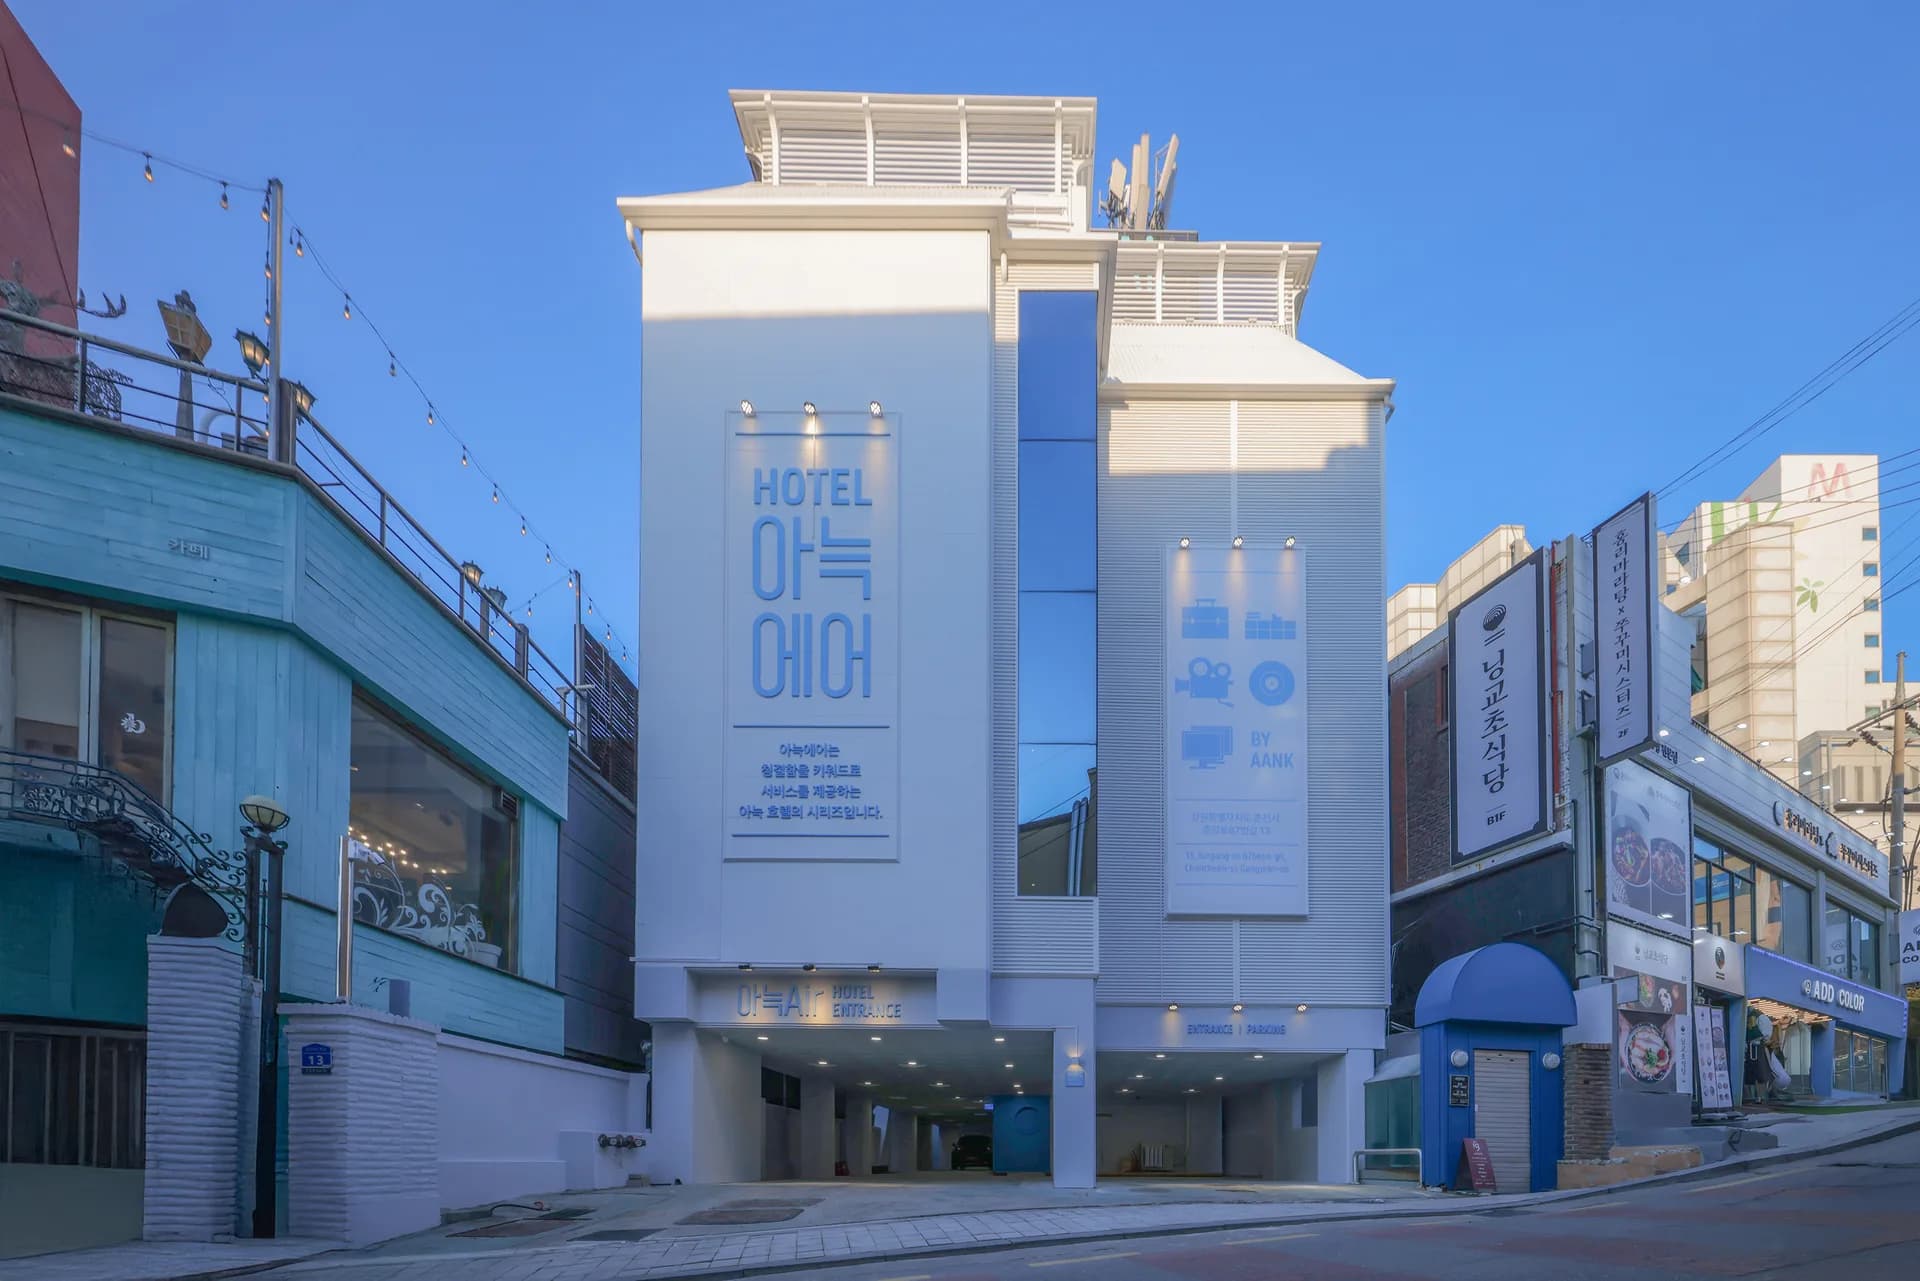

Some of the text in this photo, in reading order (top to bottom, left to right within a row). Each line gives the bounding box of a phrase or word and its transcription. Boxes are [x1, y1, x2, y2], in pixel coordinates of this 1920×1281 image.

[753, 467, 873, 506] HOTEL
[167, 538, 209, 560] 카페
[752, 514, 871, 601] 아늑
[752, 612, 871, 698] 에어
[1480, 648, 1509, 794] 닝교초식당
[1250, 731, 1271, 747] BY
[1617, 728, 1630, 739] 2F
[779, 743, 840, 758] 아늑에어는
[1250, 752, 1295, 769] AANK
[761, 764, 862, 779] 청결함을 키워드로
[761, 785, 861, 799] 서비스를 제공하는
[739, 804, 884, 820] 아늑 호텔의 시리즈입니다.
[1487, 810, 1508, 826] B1F
[832, 984, 874, 1000] HOTEL
[1813, 980, 1865, 1012] ADD COLOR
[832, 1003, 902, 1018] ENTRANCE
[1187, 1024, 1287, 1035] ENTRANCE PARKING
[308, 1055, 324, 1066] 13
